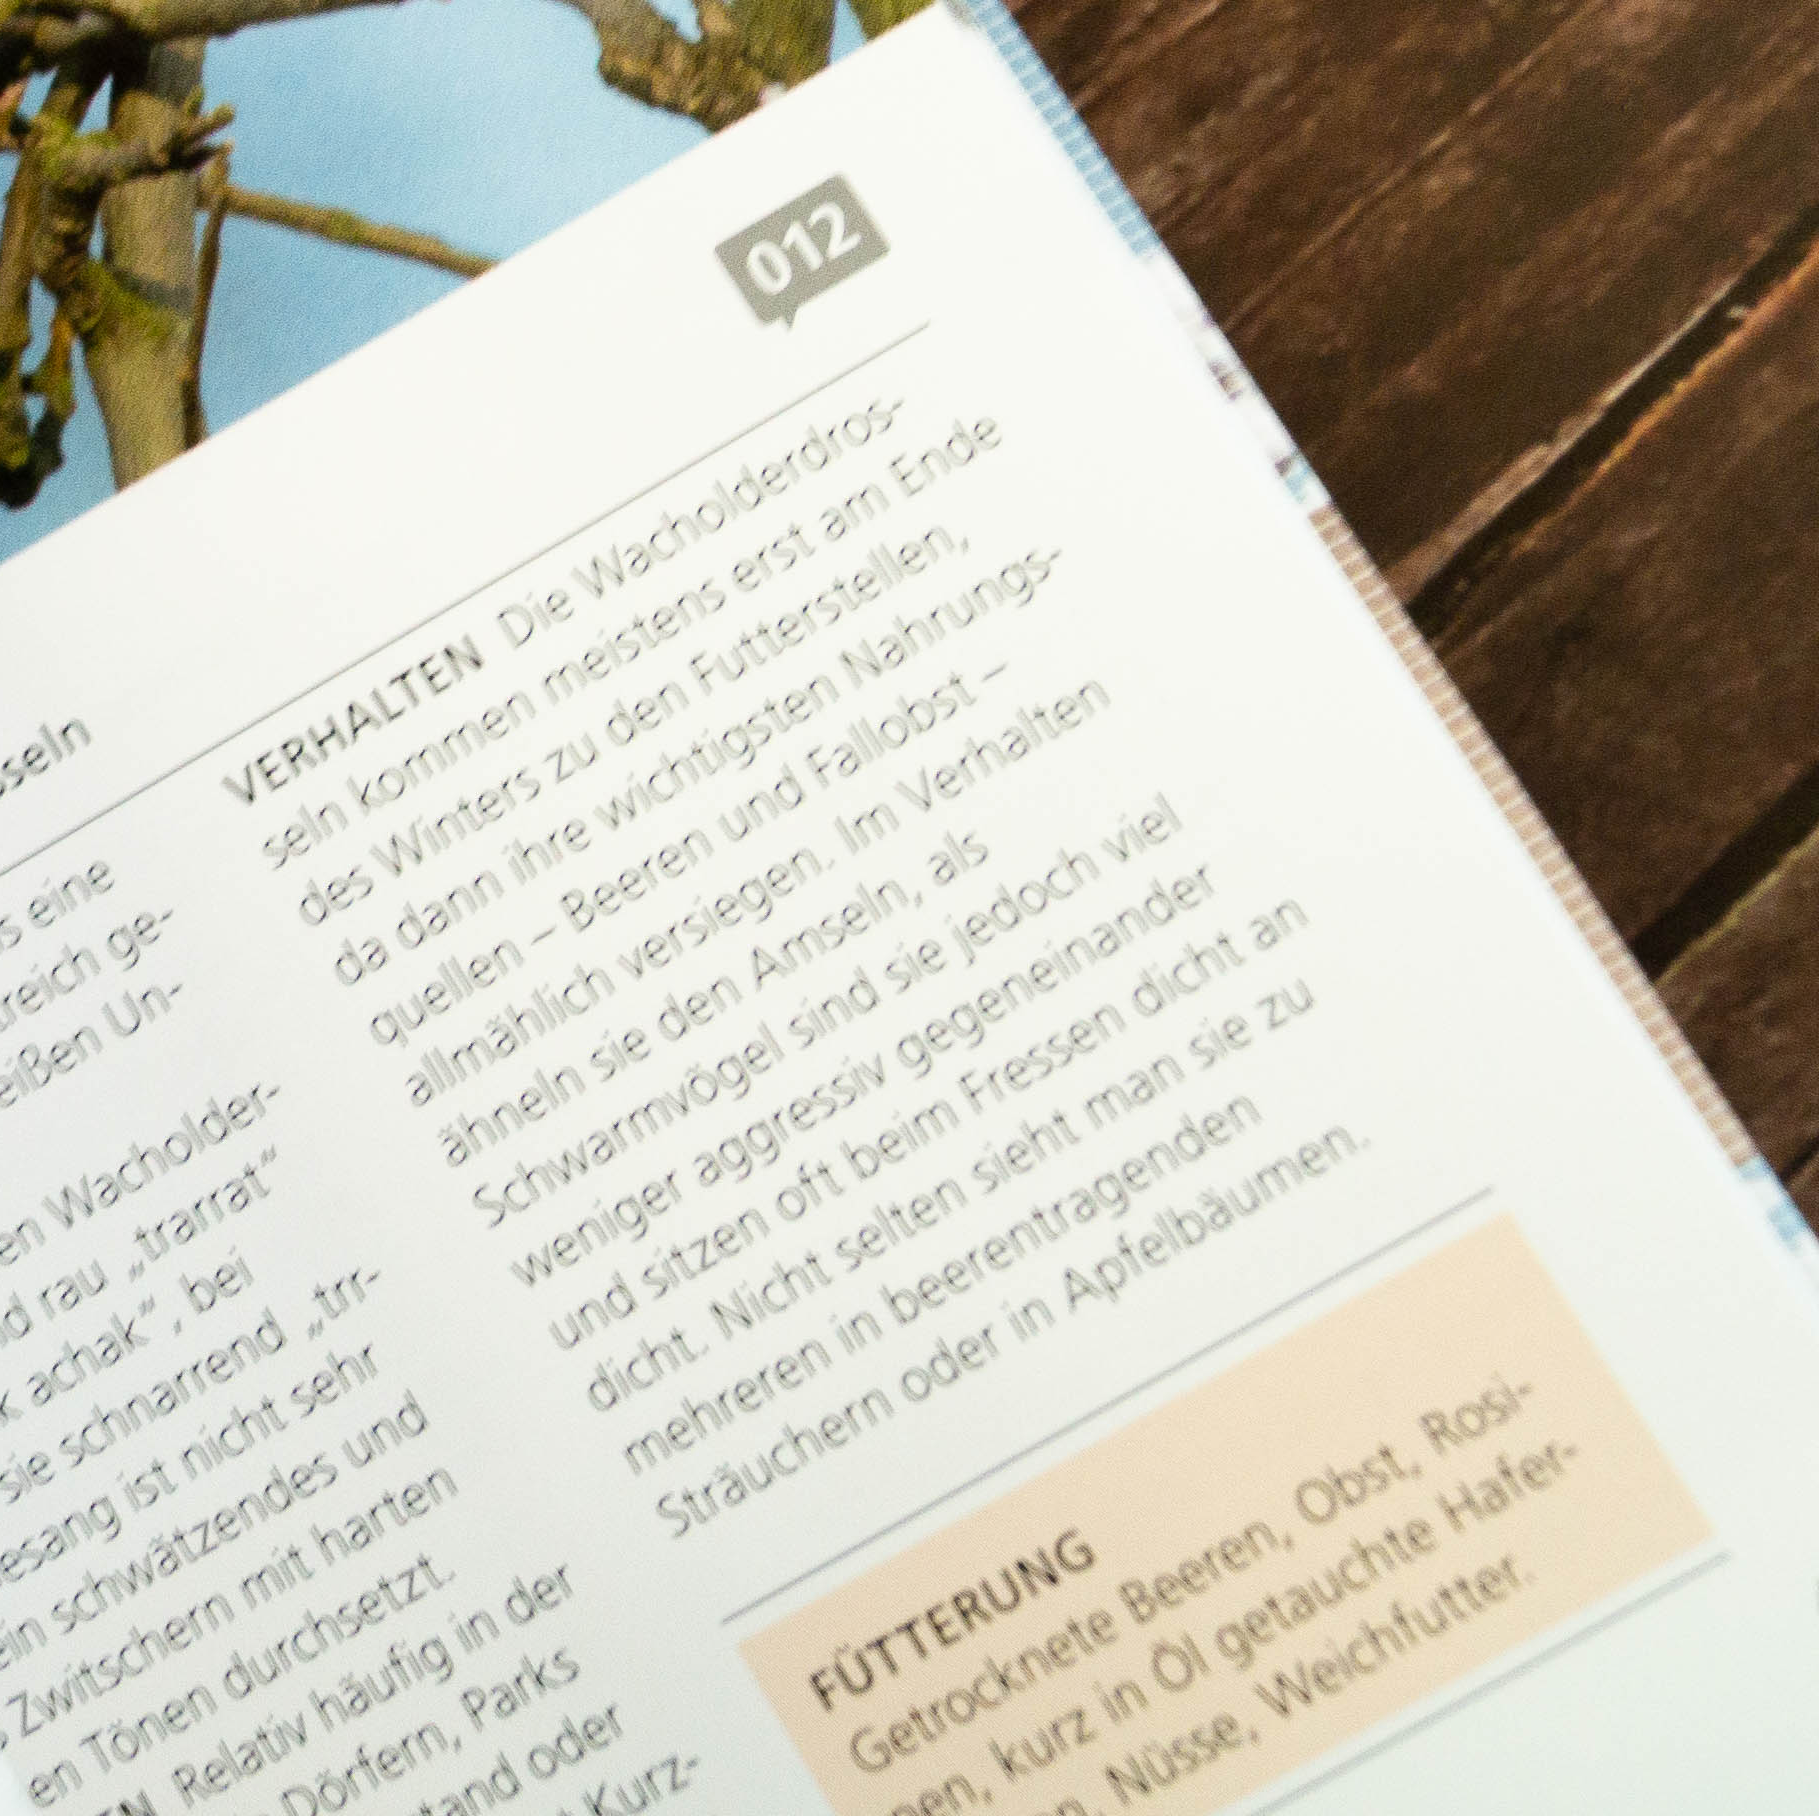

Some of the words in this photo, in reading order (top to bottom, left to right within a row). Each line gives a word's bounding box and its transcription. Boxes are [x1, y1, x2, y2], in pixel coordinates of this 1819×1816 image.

[746, 201, 864, 296] 012
[221, 634, 485, 807] VERHALTEN
[496, 590, 574, 649] Die
[573, 400, 903, 599] Wacholderdros-
[261, 802, 349, 871] seln
[345, 691, 537, 816] kommen
[541, 578, 727, 705] meistens
[731, 523, 816, 593] erst
[819, 484, 890, 543] am
[888, 418, 1002, 498] Ende
[298, 864, 375, 927] des
[369, 766, 542, 878] Winters
[543, 733, 601, 785] zu
[605, 682, 690, 747] den
[688, 526, 970, 696] Futterstellen,
[26, 860, 115, 929] eine
[333, 936, 391, 987] da
[395, 870, 505, 950] dann
[503, 819, 592, 885] ihre
[594, 675, 840, 832] wichtigsten
[838, 549, 1062, 689] Nahrungs-
[369, 939, 525, 1048] quellen
[558, 829, 714, 934] Beeren
[717, 763, 807, 843] und
[804, 671, 978, 789] Fallobst
[405, 964, 616, 1108] allmählich
[617, 848, 835, 981] versiegen.
[834, 803, 900, 855] Im
[895, 680, 1111, 813] Verhalten
[101, 983, 183, 1038] Un-
[106, 909, 174, 972] ge-
[437, 1066, 586, 1168] ähneln
[589, 1027, 652, 1083] sie
[657, 976, 743, 1042] den
[750, 880, 923, 992] Amseln,
[927, 831, 990, 887] als
[471, 1021, 785, 1230] Schwarmvögel
[787, 965, 881, 1051] sind
[883, 939, 948, 995] sie
[945, 848, 1100, 968] jedoch
[1101, 792, 1182, 864] viel
[42, 1083, 281, 1231] Wacholder-
[509, 1169, 682, 1288] weniger
[692, 1053, 886, 1188] aggressiv
[895, 864, 1214, 1081] gegeneinander
[549, 1270, 639, 1351] und
[640, 1208, 771, 1301] sitzen
[774, 1159, 846, 1223] oft
[839, 1099, 960, 1182] beim
[956, 1004, 1127, 1115] Fressen
[1131, 931, 1247, 1018] dicht
[1248, 899, 1309, 952] an
[586, 1326, 710, 1413] dicht.
[708, 1249, 834, 1342] Nicht
[834, 1178, 968, 1273] selten
[970, 1109, 1082, 1196] sieht
[1082, 1054, 1185, 1130] man
[1188, 1014, 1253, 1071] sie
[1255, 979, 1316, 1032] zu
[26, 1295, 183, 1408] achak“,
[178, 1246, 254, 1315] bei
[37, 1260, 110, 1320] rau
[128, 1144, 278, 1283] „trarrat“
[622, 1339, 833, 1476] mehreren
[829, 1310, 884, 1355] in
[878, 1096, 1262, 1327] beerentragenden
[655, 1388, 895, 1540] Sträuchern
[899, 1323, 1000, 1404] oder
[1001, 1297, 1056, 1343] in
[1062, 1126, 1370, 1314] Apfelbäumen.
[58, 1306, 288, 1469] schnarrend
[307, 1268, 381, 1340] „trr-
[116, 1458, 178, 1513] ist
[179, 1395, 289, 1480] nicht
[289, 1342, 378, 1419] sehr
[4, 1593, 235, 1739] Zwitschern
[238, 1543, 316, 1610] mit
[309, 1467, 459, 1567] harten
[50, 1452, 339, 1636] schwätzendes
[341, 1388, 430, 1469] und
[808, 1528, 1097, 1713] FÜTTERUNG
[848, 1608, 1120, 1775] Getrocknete
[1116, 1521, 1295, 1627] Beeren,
[1293, 1442, 1423, 1527] Obst,
[1417, 1372, 1533, 1457] Rosi-
[987, 1705, 1099, 1785] kurz
[1092, 1679, 1150, 1726] in
[1149, 1631, 1211, 1694] Öl
[1214, 1518, 1438, 1674] getauchte
[1435, 1440, 1579, 1534] Hafer-
[78, 1685, 218, 1774] Tönen
[222, 1552, 456, 1701] durchsetzt.
[170, 1711, 309, 1814] Relativ
[308, 1635, 455, 1733] häufig
[448, 1610, 501, 1654] in
[504, 1563, 573, 1627] der
[459, 1647, 581, 1733] Parks
[526, 1702, 623, 1781] oder
[1101, 1712, 1261, 1815] Nüsse,
[1252, 1553, 1534, 1721] Weichfutter.
